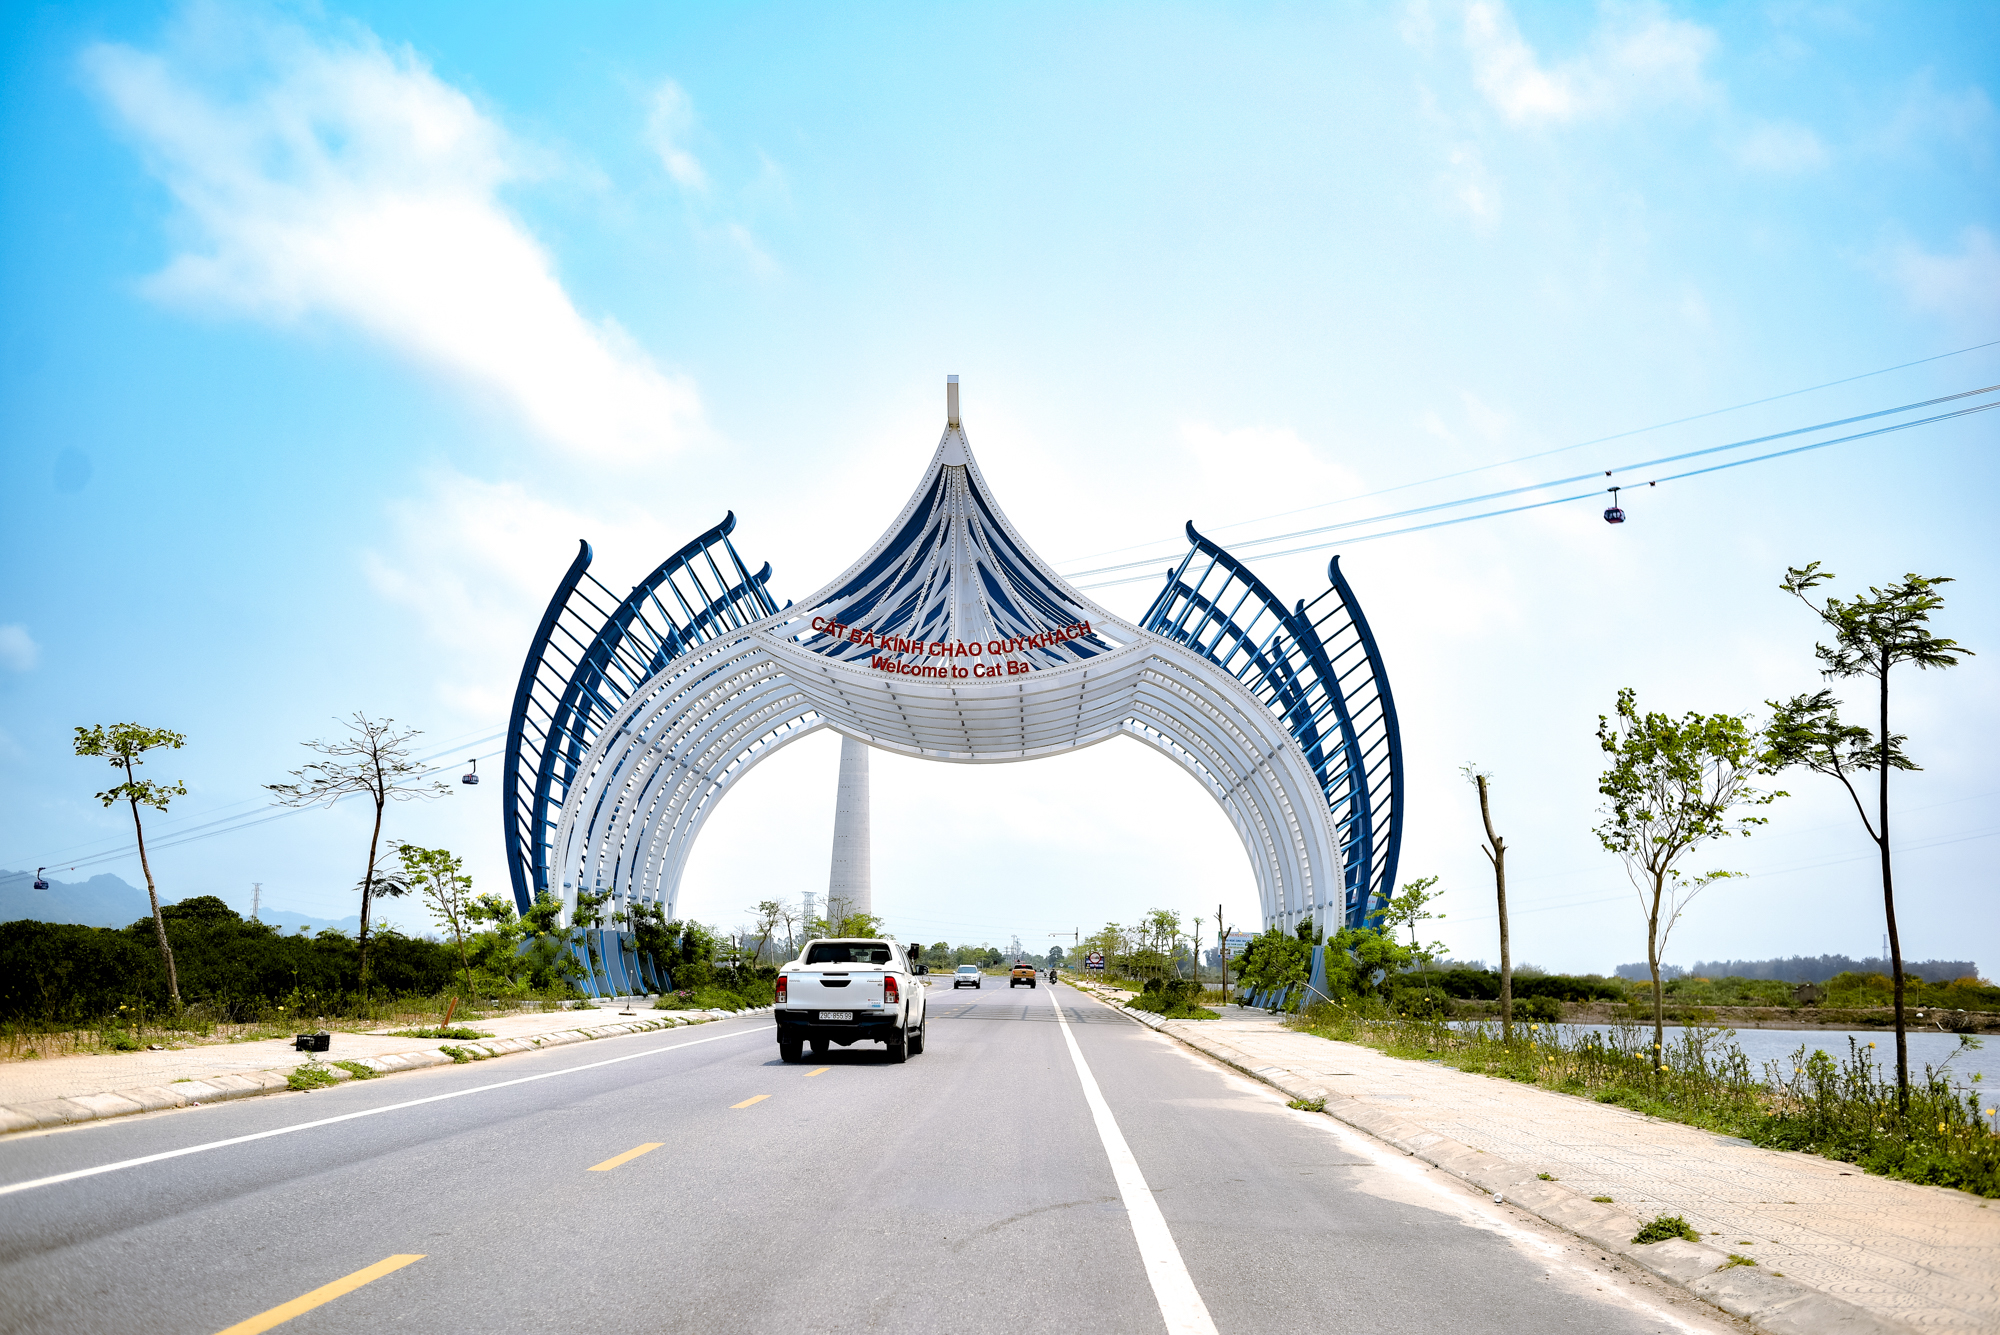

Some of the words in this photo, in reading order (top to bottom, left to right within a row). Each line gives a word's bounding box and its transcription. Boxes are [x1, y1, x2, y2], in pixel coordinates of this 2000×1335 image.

[812, 616, 848, 639] CÁT
[850, 628, 875, 648] BÀ
[880, 633, 924, 655] KÍNH
[929, 639, 982, 657] CHÀO
[988, 634, 1025, 656] QUÝ
[1028, 620, 1092, 649] KHÁCH
[871, 654, 948, 678] Welcome
[952, 664, 969, 678] to
[973, 662, 1002, 678] Cat
[1007, 660, 1030, 676] Ba
